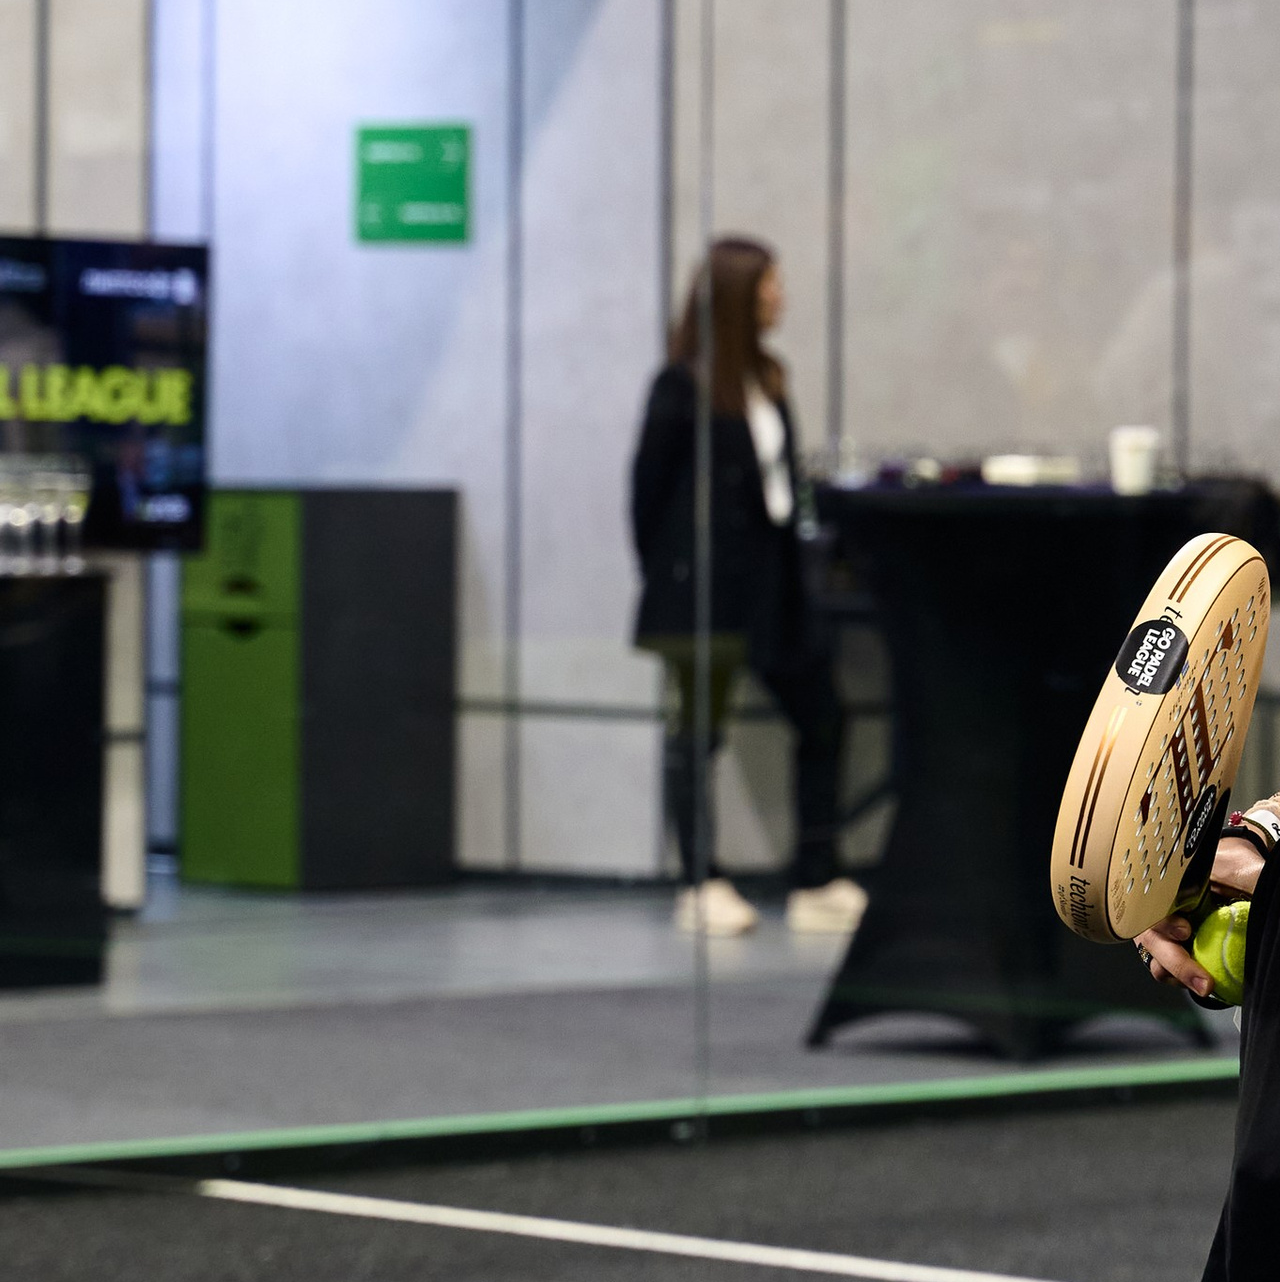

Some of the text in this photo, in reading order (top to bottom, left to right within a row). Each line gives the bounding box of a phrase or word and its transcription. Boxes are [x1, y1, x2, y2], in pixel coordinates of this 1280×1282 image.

[20, 363, 192, 426] LEAGUE
[1127, 628, 1161, 677] LEAGUE
[1156, 627, 1176, 650] GO
[1136, 648, 1166, 687] PADEL
